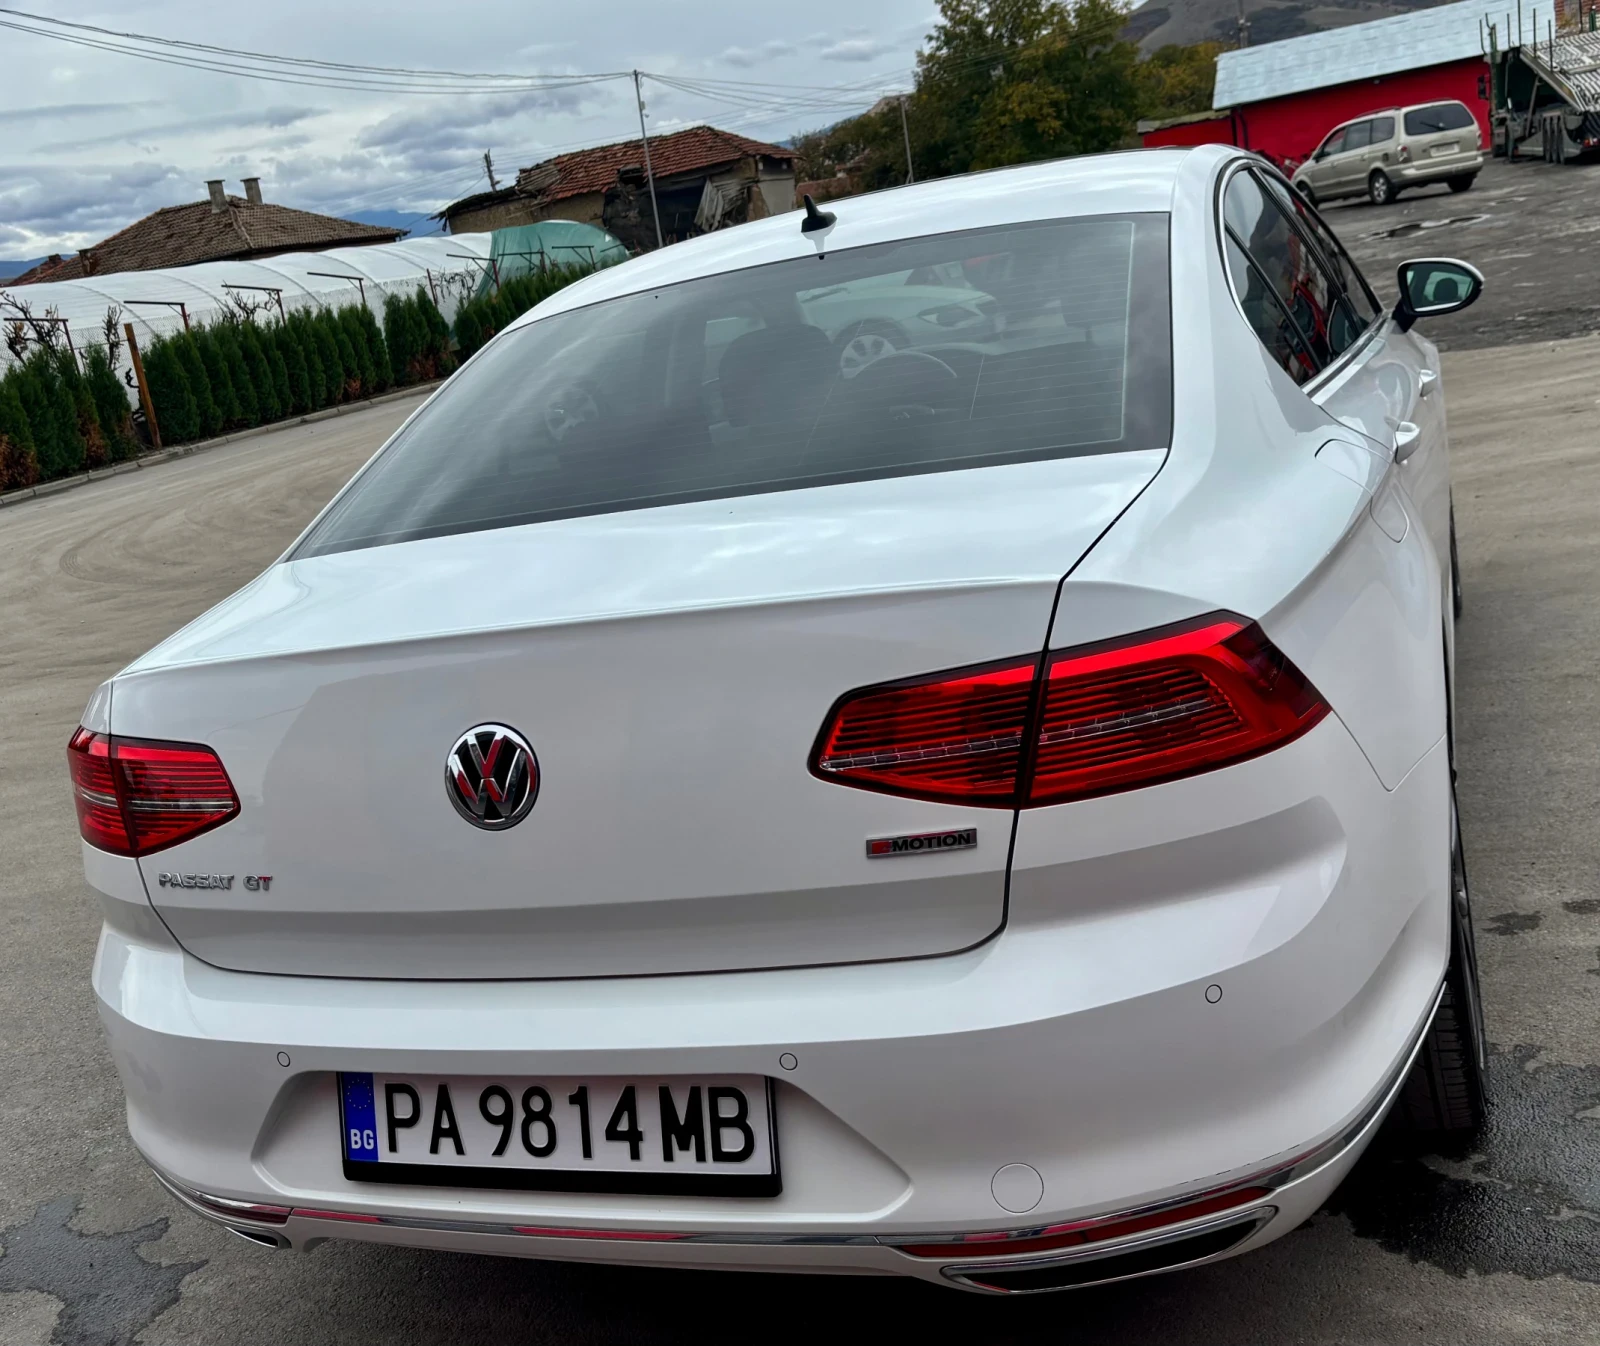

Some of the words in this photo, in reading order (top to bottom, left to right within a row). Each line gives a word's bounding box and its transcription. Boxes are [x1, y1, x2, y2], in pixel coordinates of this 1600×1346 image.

[158, 872, 235, 890] PASSAT
[242, 874, 273, 891] GT
[384, 1083, 465, 1156] PA
[478, 1084, 644, 1161] 9814
[658, 1085, 756, 1163] MB
[350, 1128, 375, 1150] BG
